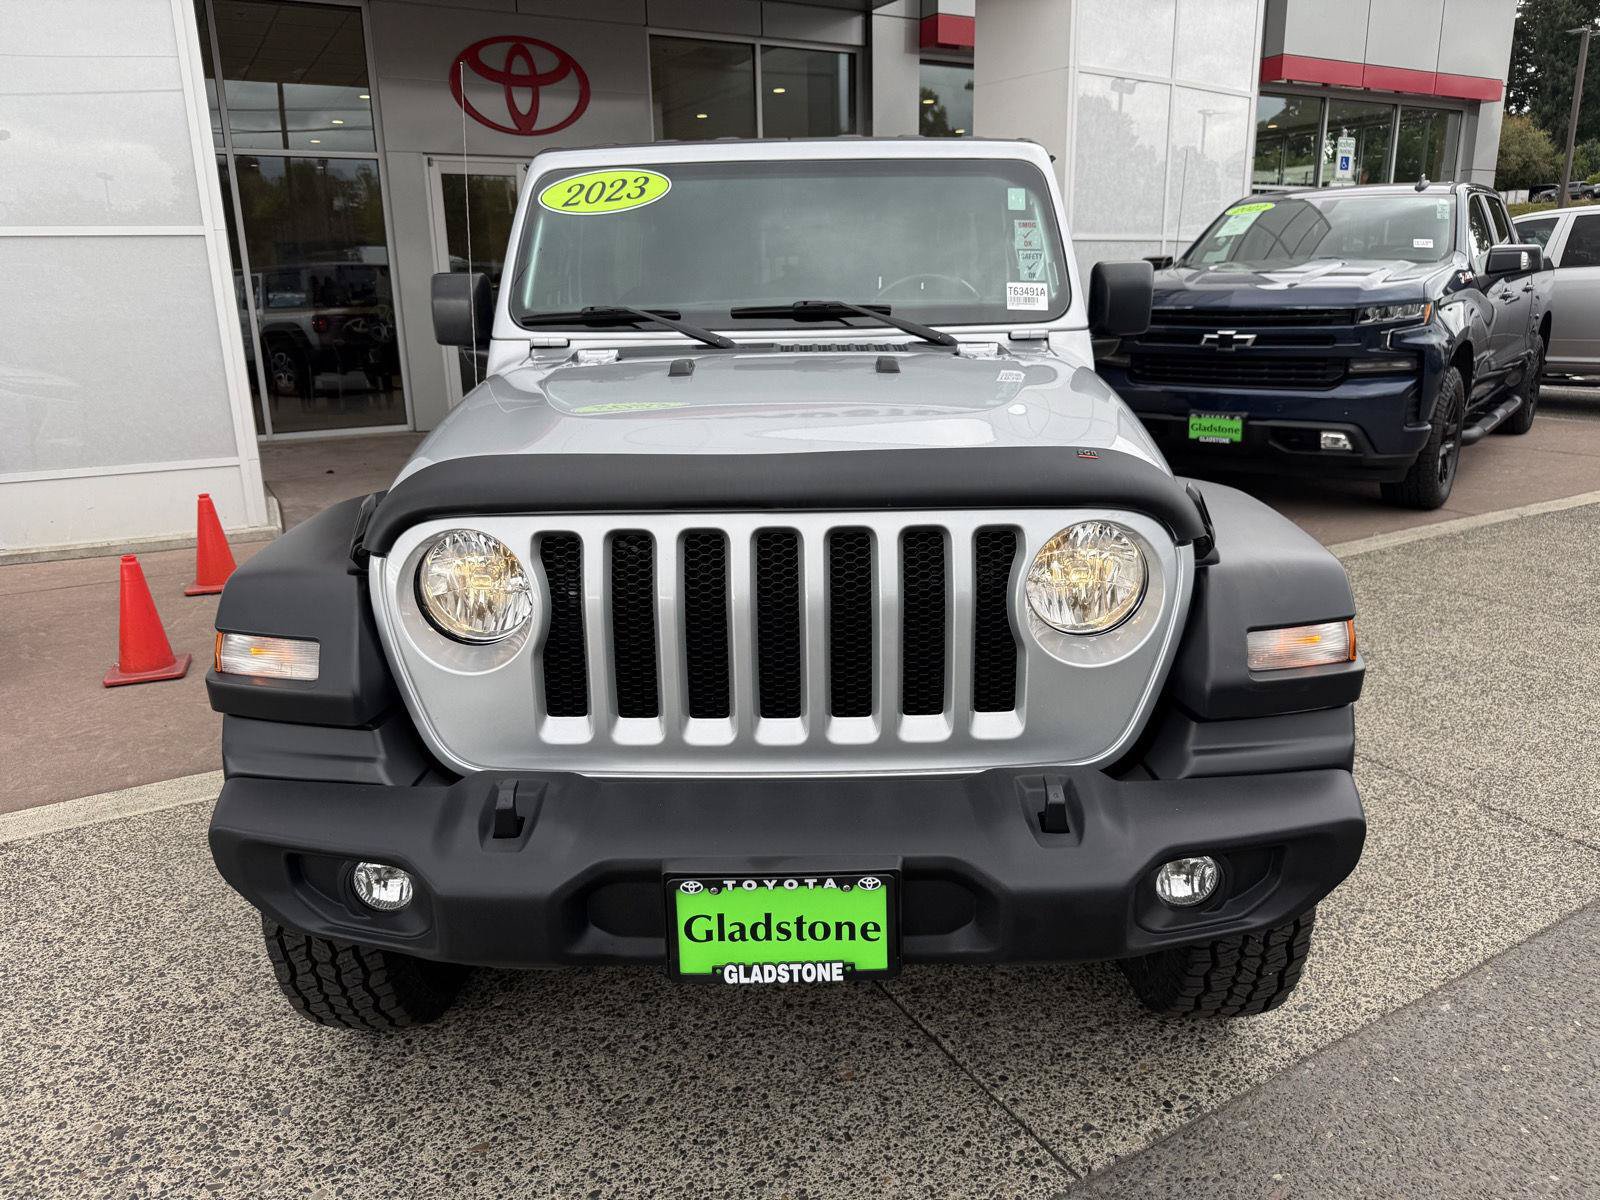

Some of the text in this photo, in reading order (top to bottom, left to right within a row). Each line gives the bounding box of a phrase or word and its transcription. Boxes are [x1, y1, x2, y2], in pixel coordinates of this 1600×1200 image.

[562, 176, 650, 207] 2023
[1021, 252, 1043, 260] SAFETY
[1008, 286, 1046, 297] T63491A
[1190, 423, 1241, 435] Gladstone
[723, 878, 838, 891] TOYOTA
[683, 912, 882, 943] Gladstone
[723, 962, 844, 984] GLADSTONE
